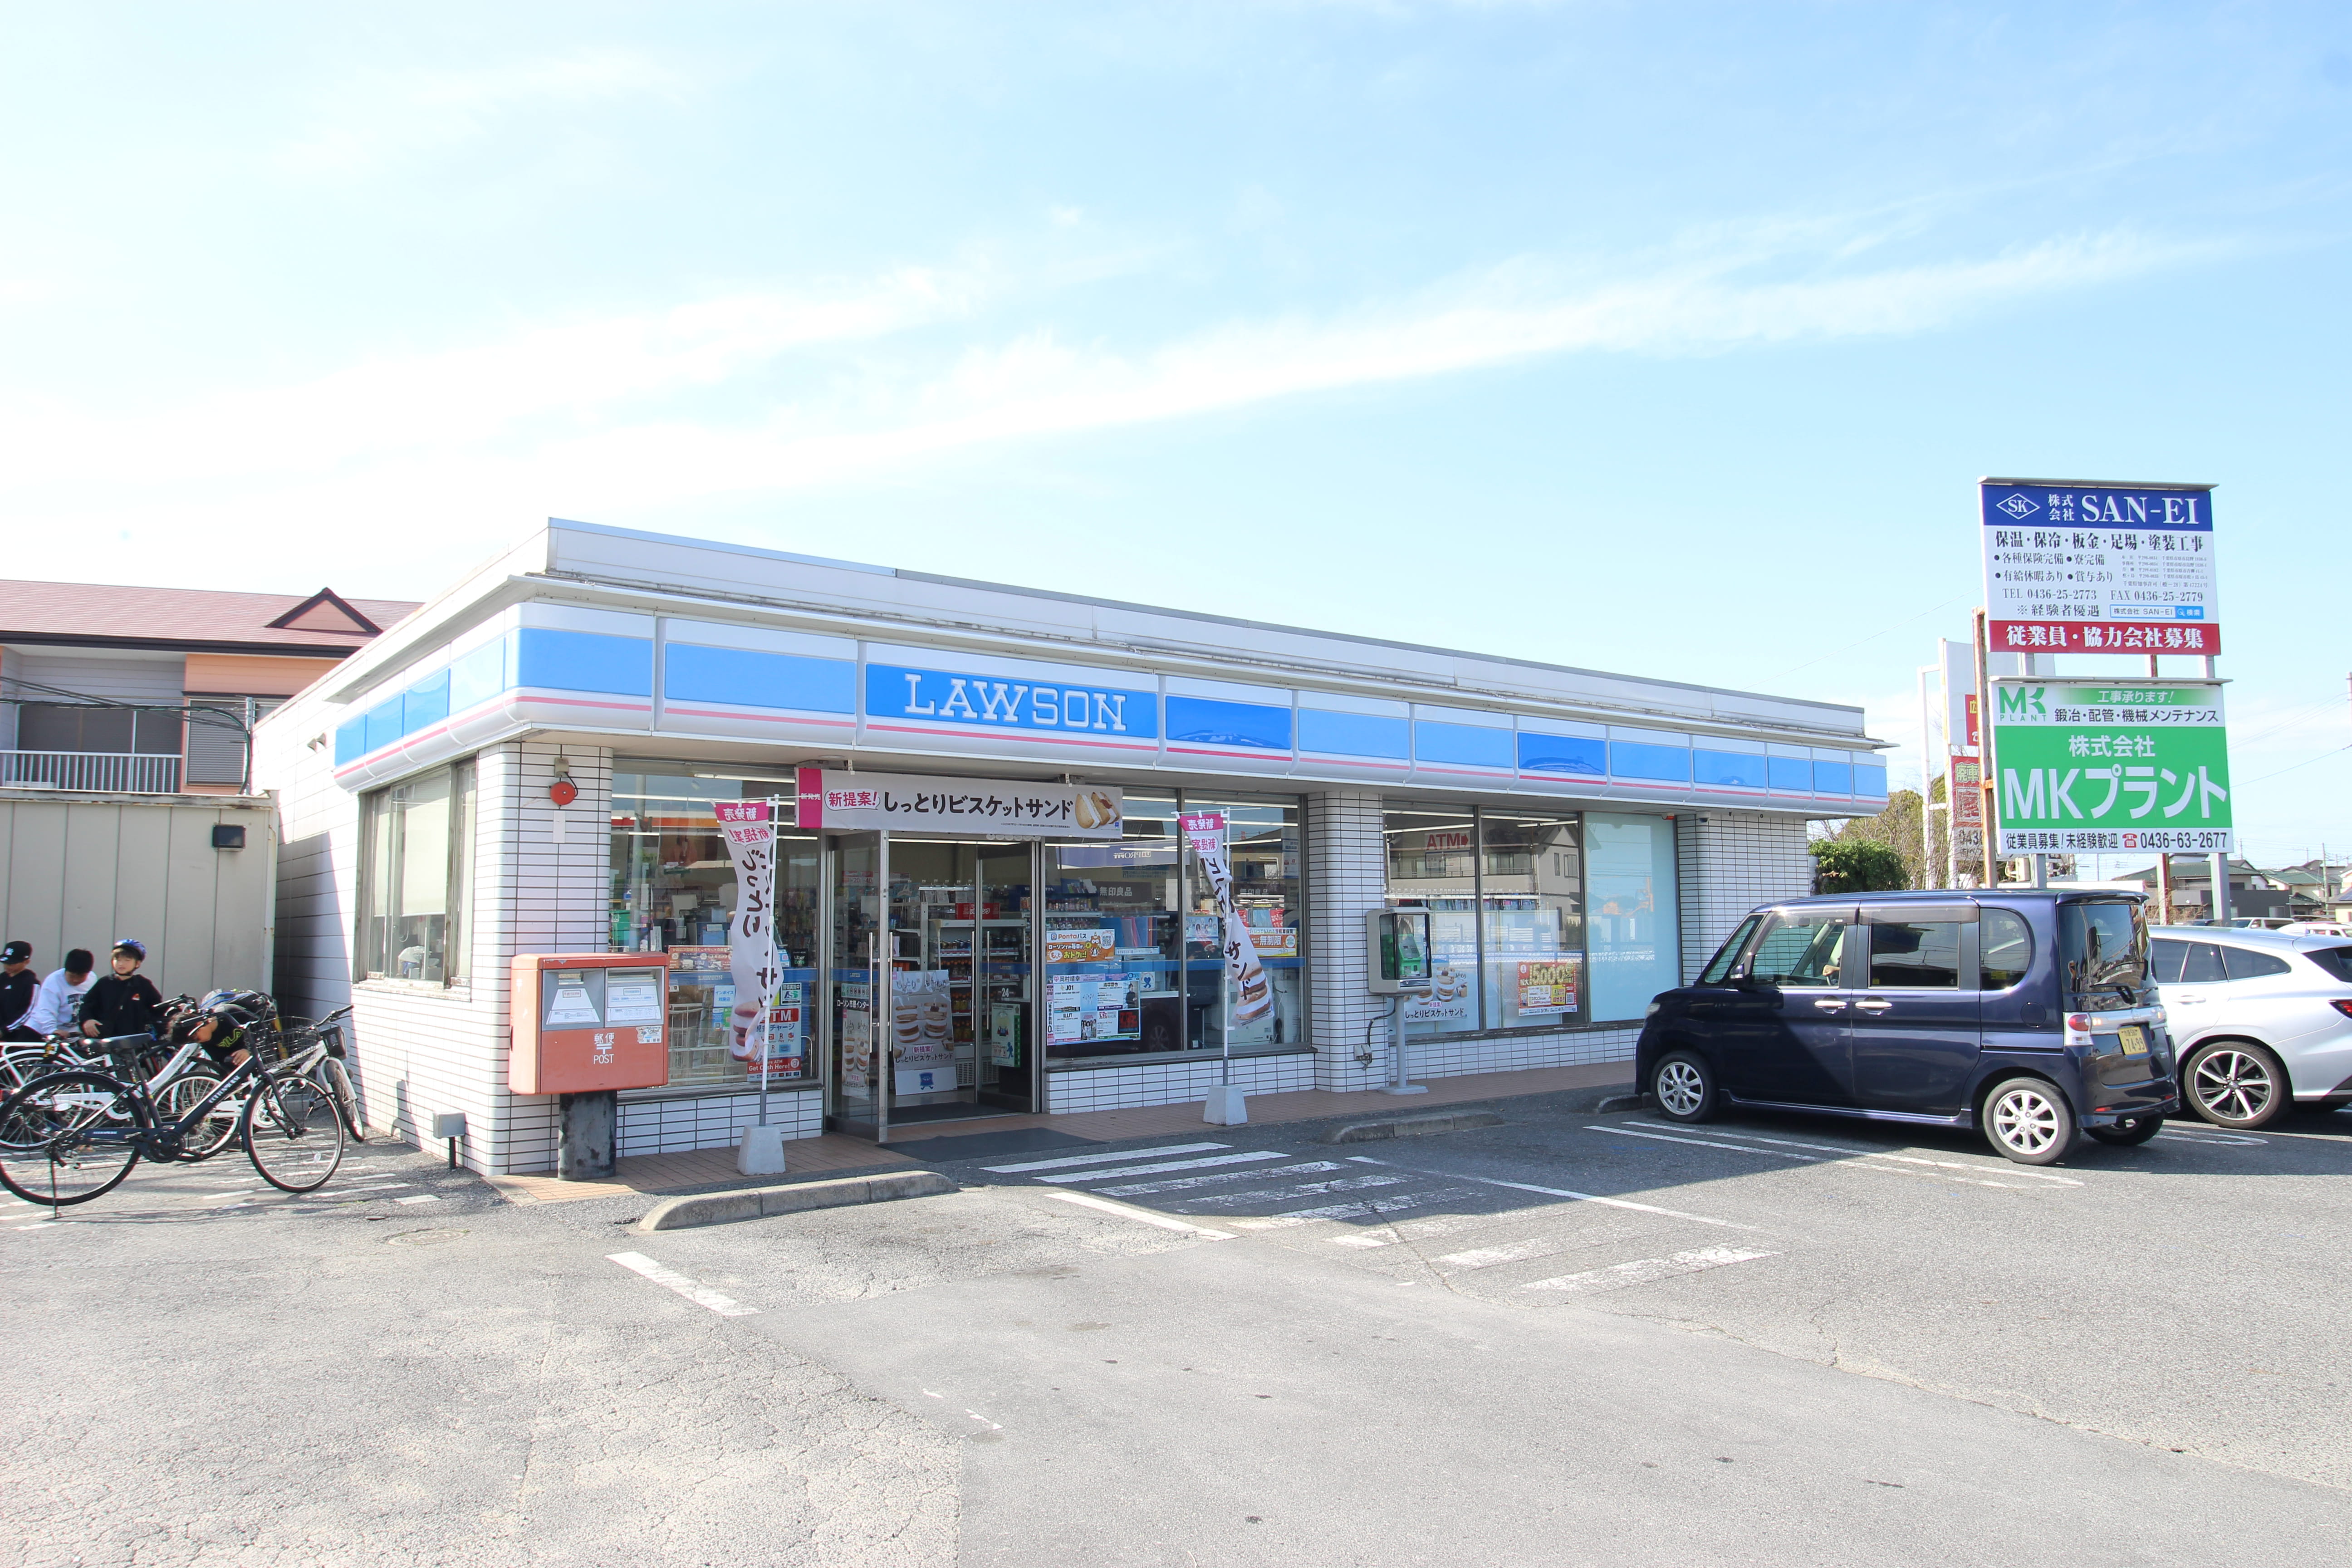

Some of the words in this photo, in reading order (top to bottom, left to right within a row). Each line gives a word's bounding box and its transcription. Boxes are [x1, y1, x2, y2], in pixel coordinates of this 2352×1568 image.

[2008, 500, 2027, 512] SK
[2082, 495, 2199, 524] SAN-EI
[2003, 588, 2022, 598] TEL
[2027, 588, 2097, 599] 0436-25-2773
[2110, 590, 2131, 601] FAX
[2134, 591, 2203, 602] 0436-25-2779
[2006, 625, 2204, 648] 従業員・協力会社募集
[904, 673, 1127, 731] LAWSON
[1999, 686, 2045, 714] MK
[2068, 735, 2156, 758] 株式会社
[884, 791, 1073, 821] しっとりビスケットサンド
[1426, 833, 1460, 851] ATM
[2140, 833, 2227, 849] 0436-63-2677
[1099, 887, 1132, 897] 無印良品
[1259, 936, 1282, 946] 無制限
[594, 1032, 615, 1044] 郵便
[593, 1054, 614, 1064] POST
